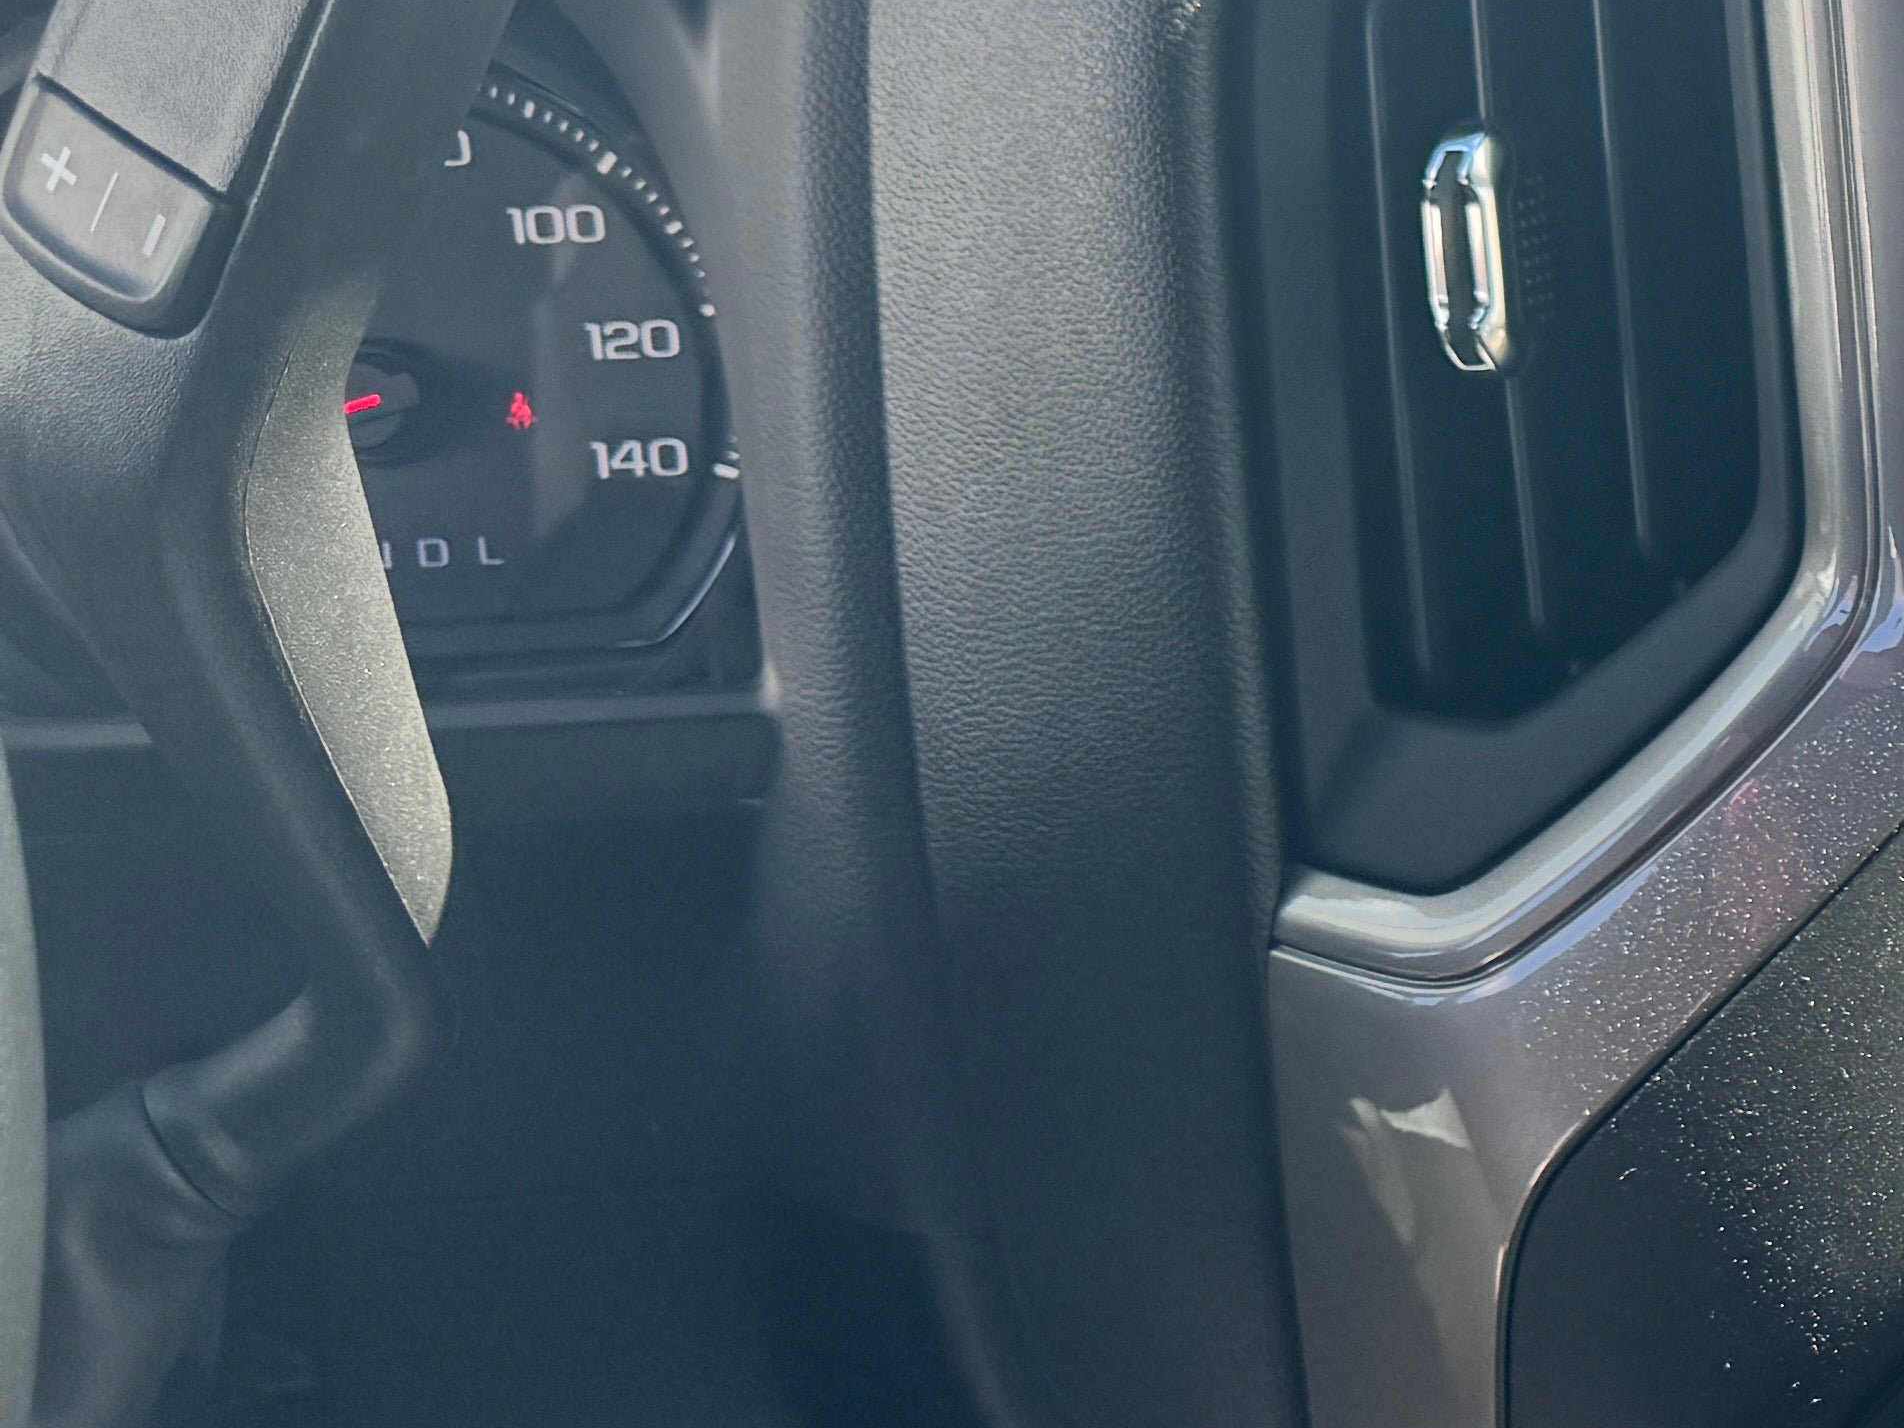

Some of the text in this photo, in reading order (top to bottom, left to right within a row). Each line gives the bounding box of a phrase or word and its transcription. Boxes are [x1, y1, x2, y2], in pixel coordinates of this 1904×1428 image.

[506, 204, 606, 245] 100
[584, 319, 681, 361] 120
[589, 437, 689, 480] 140
[417, 538, 449, 568] D
[477, 535, 505, 566] L
